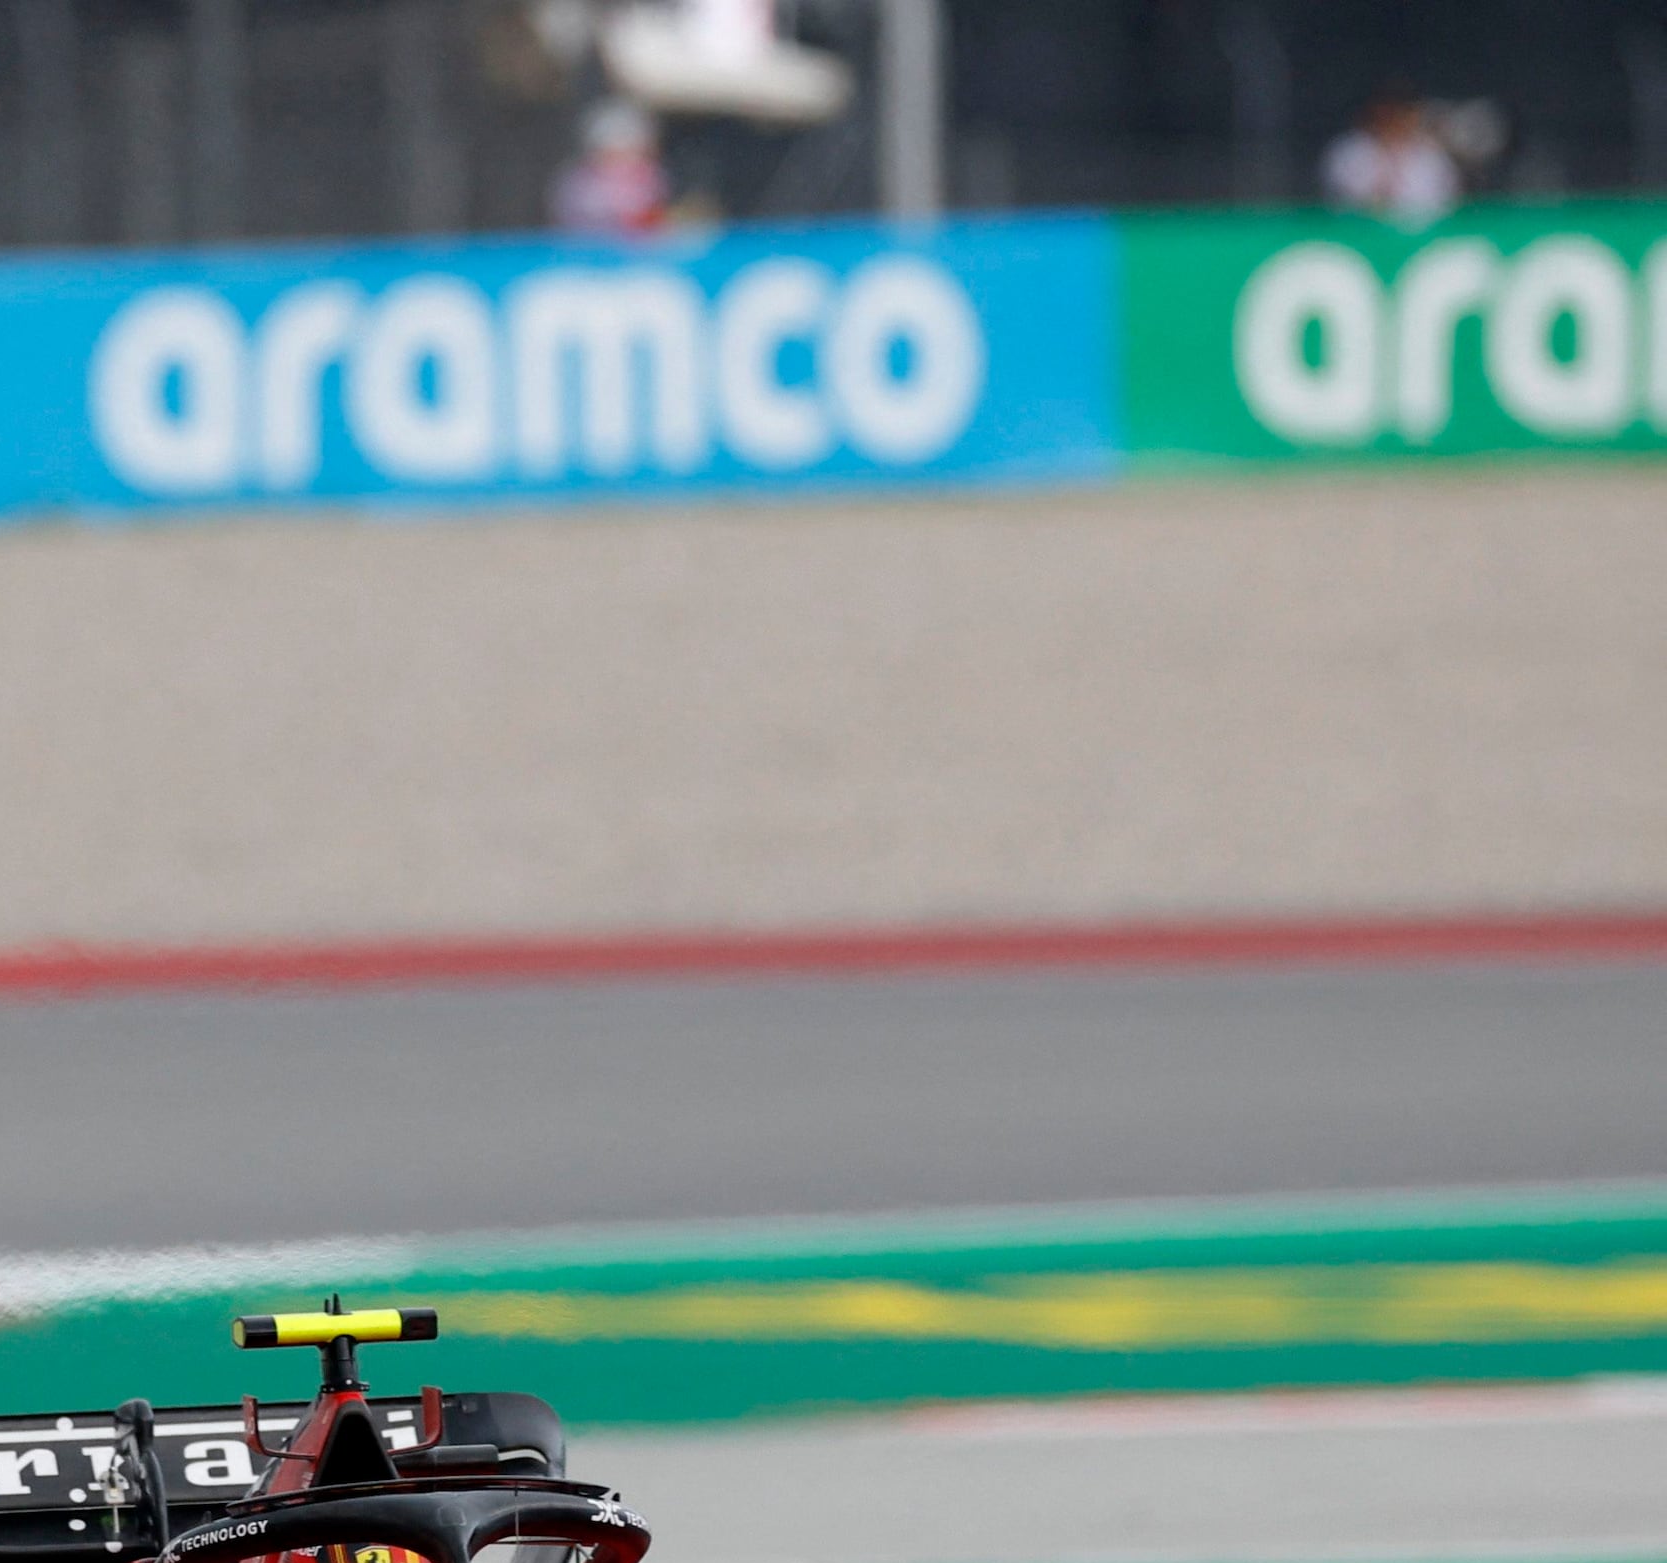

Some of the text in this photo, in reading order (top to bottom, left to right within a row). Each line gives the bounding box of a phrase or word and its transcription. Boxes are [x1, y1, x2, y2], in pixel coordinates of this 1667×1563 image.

[87, 253, 989, 495] aramco
[1232, 231, 1667, 447] ara
[181, 1519, 268, 1553] TECHNOLOGY
